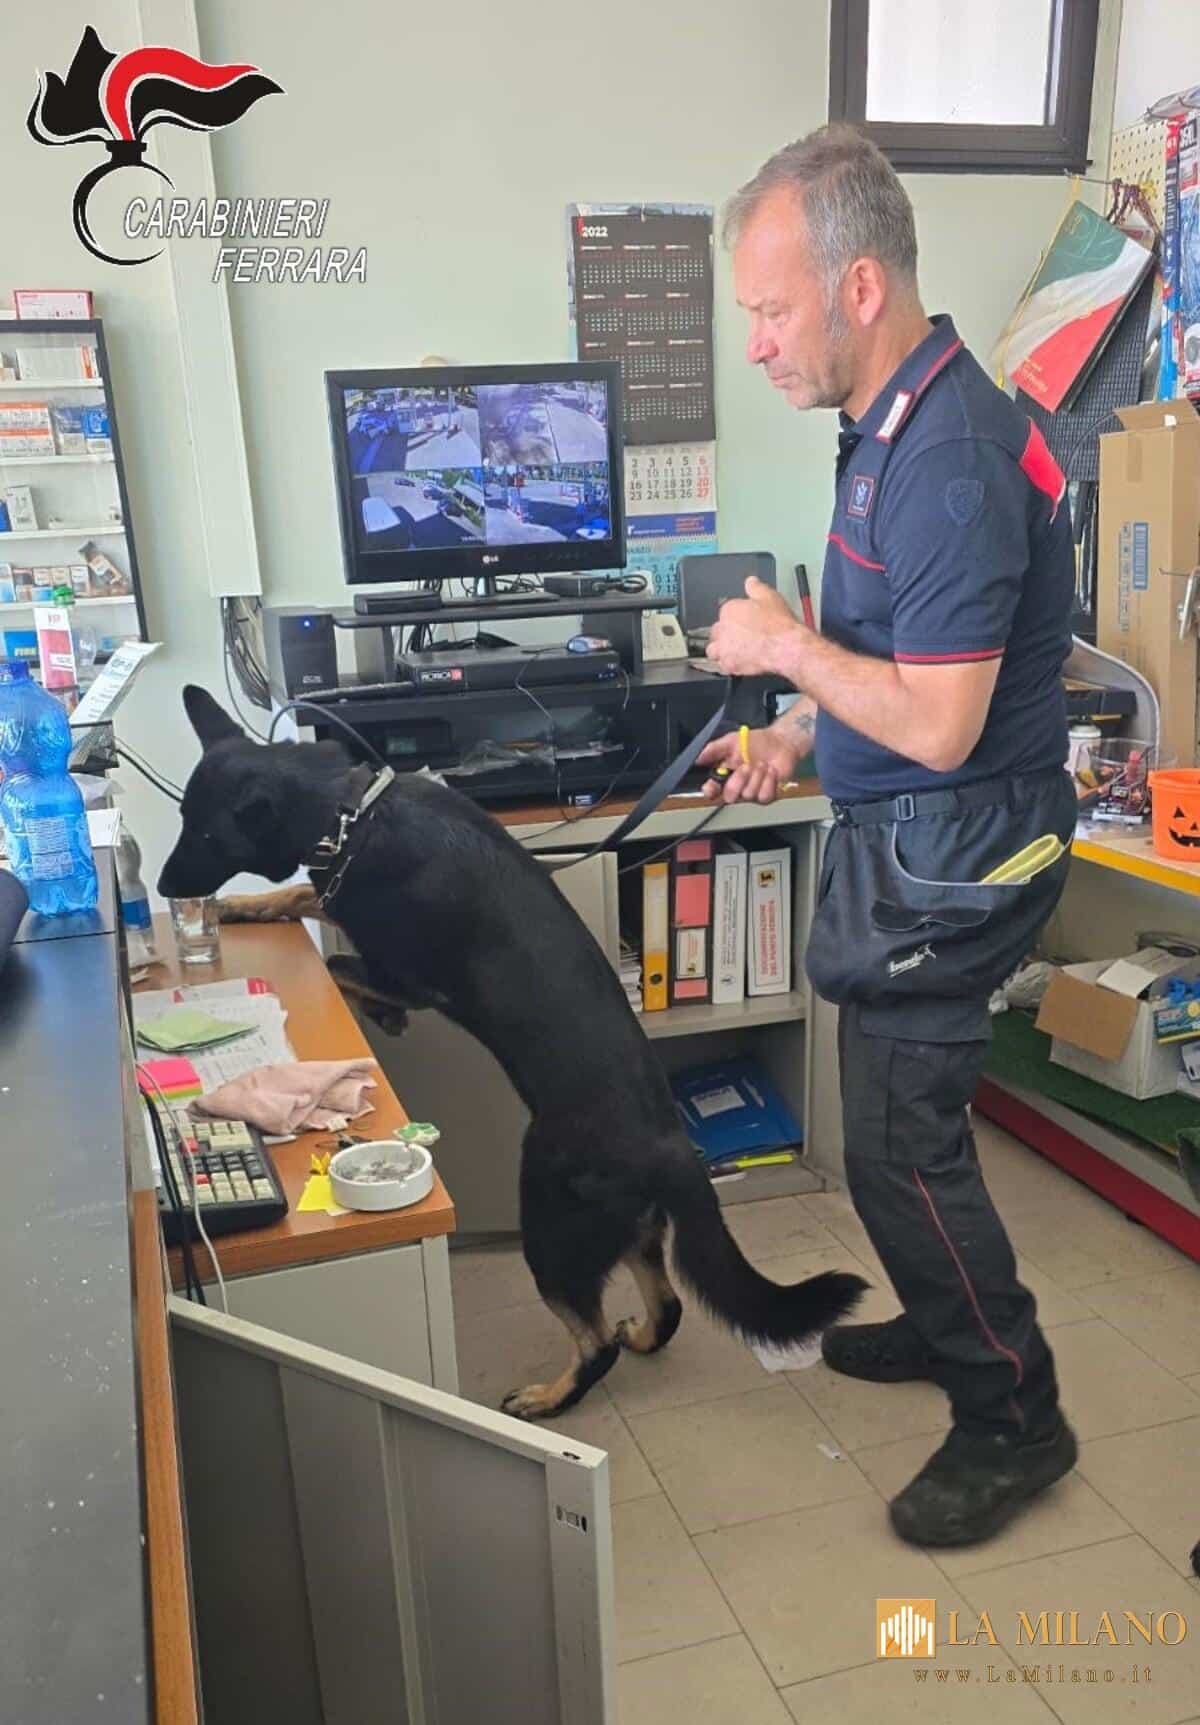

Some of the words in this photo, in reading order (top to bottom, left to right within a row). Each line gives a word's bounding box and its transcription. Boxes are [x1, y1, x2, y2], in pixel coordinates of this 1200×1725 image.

[581, 226, 608, 238] 2022
[682, 456, 689, 466] 5
[681, 466, 692, 477] 12
[630, 481, 642, 490] 16
[647, 480, 659, 489] 17
[664, 479, 676, 489] 18
[681, 478, 692, 488] 19
[630, 490, 642, 500] 23
[647, 490, 659, 500] 24
[681, 488, 692, 498] 26
